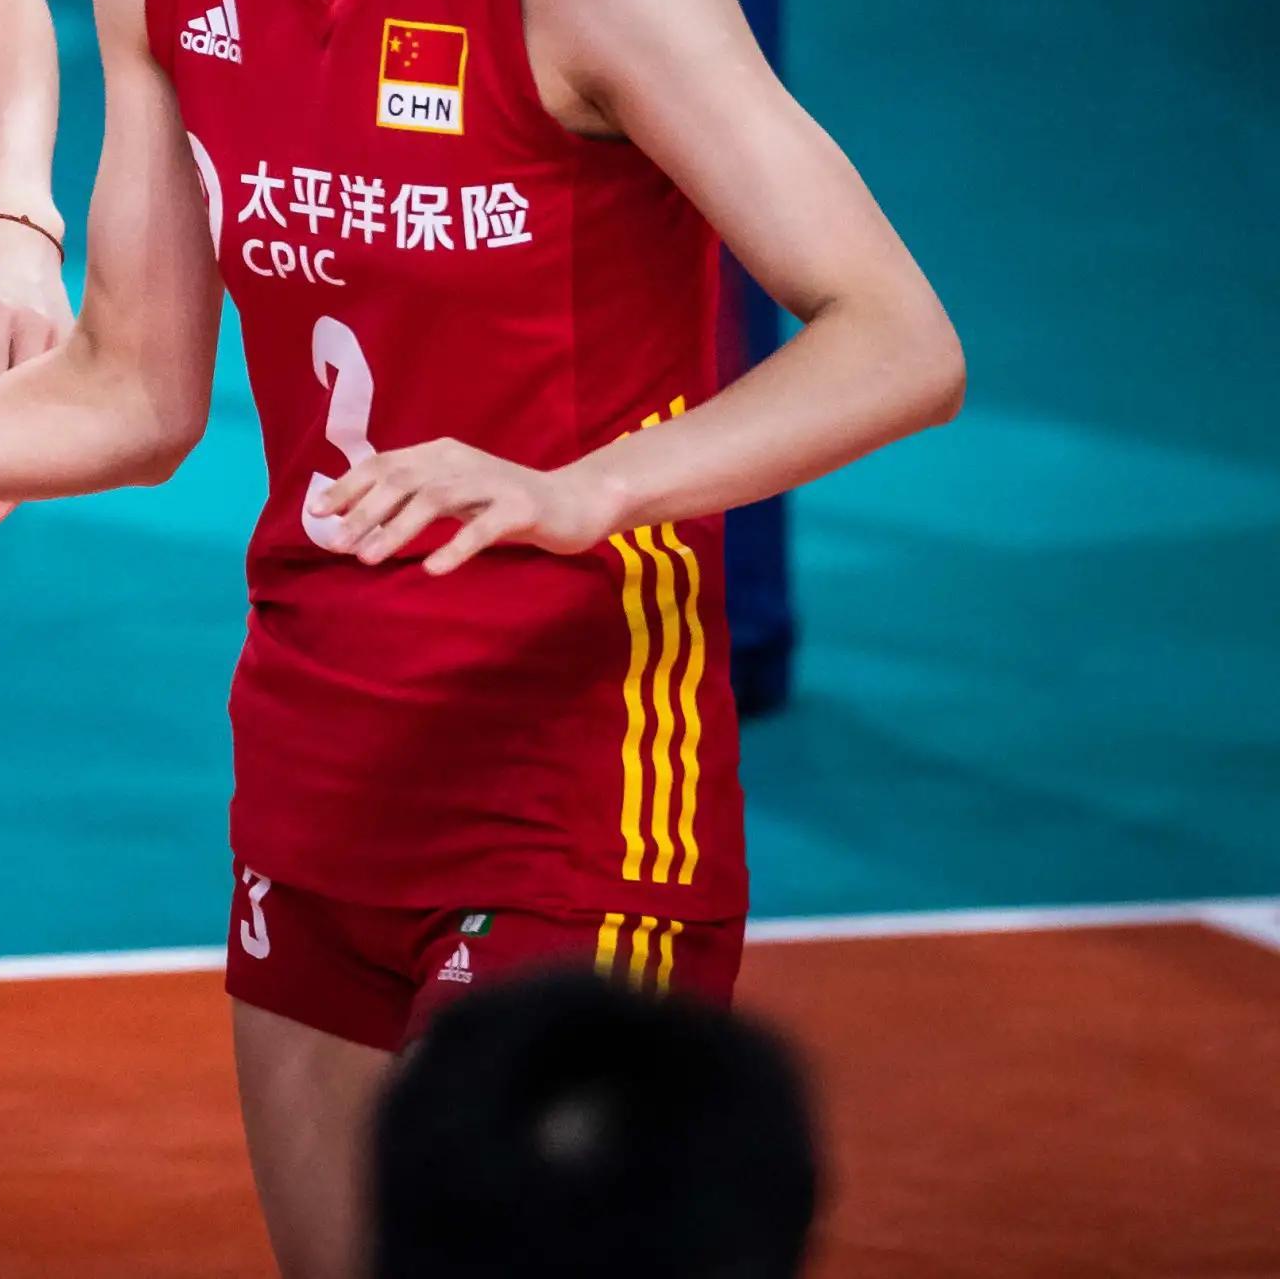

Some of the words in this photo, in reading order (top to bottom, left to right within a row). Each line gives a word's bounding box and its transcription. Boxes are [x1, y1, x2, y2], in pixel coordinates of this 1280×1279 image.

[180, 31, 242, 65] adida
[388, 93, 452, 121] CHN
[237, 160, 533, 251] 太平洋保险
[242, 238, 347, 286] CPIC
[301, 315, 377, 554] 3
[241, 866, 271, 960] 3
